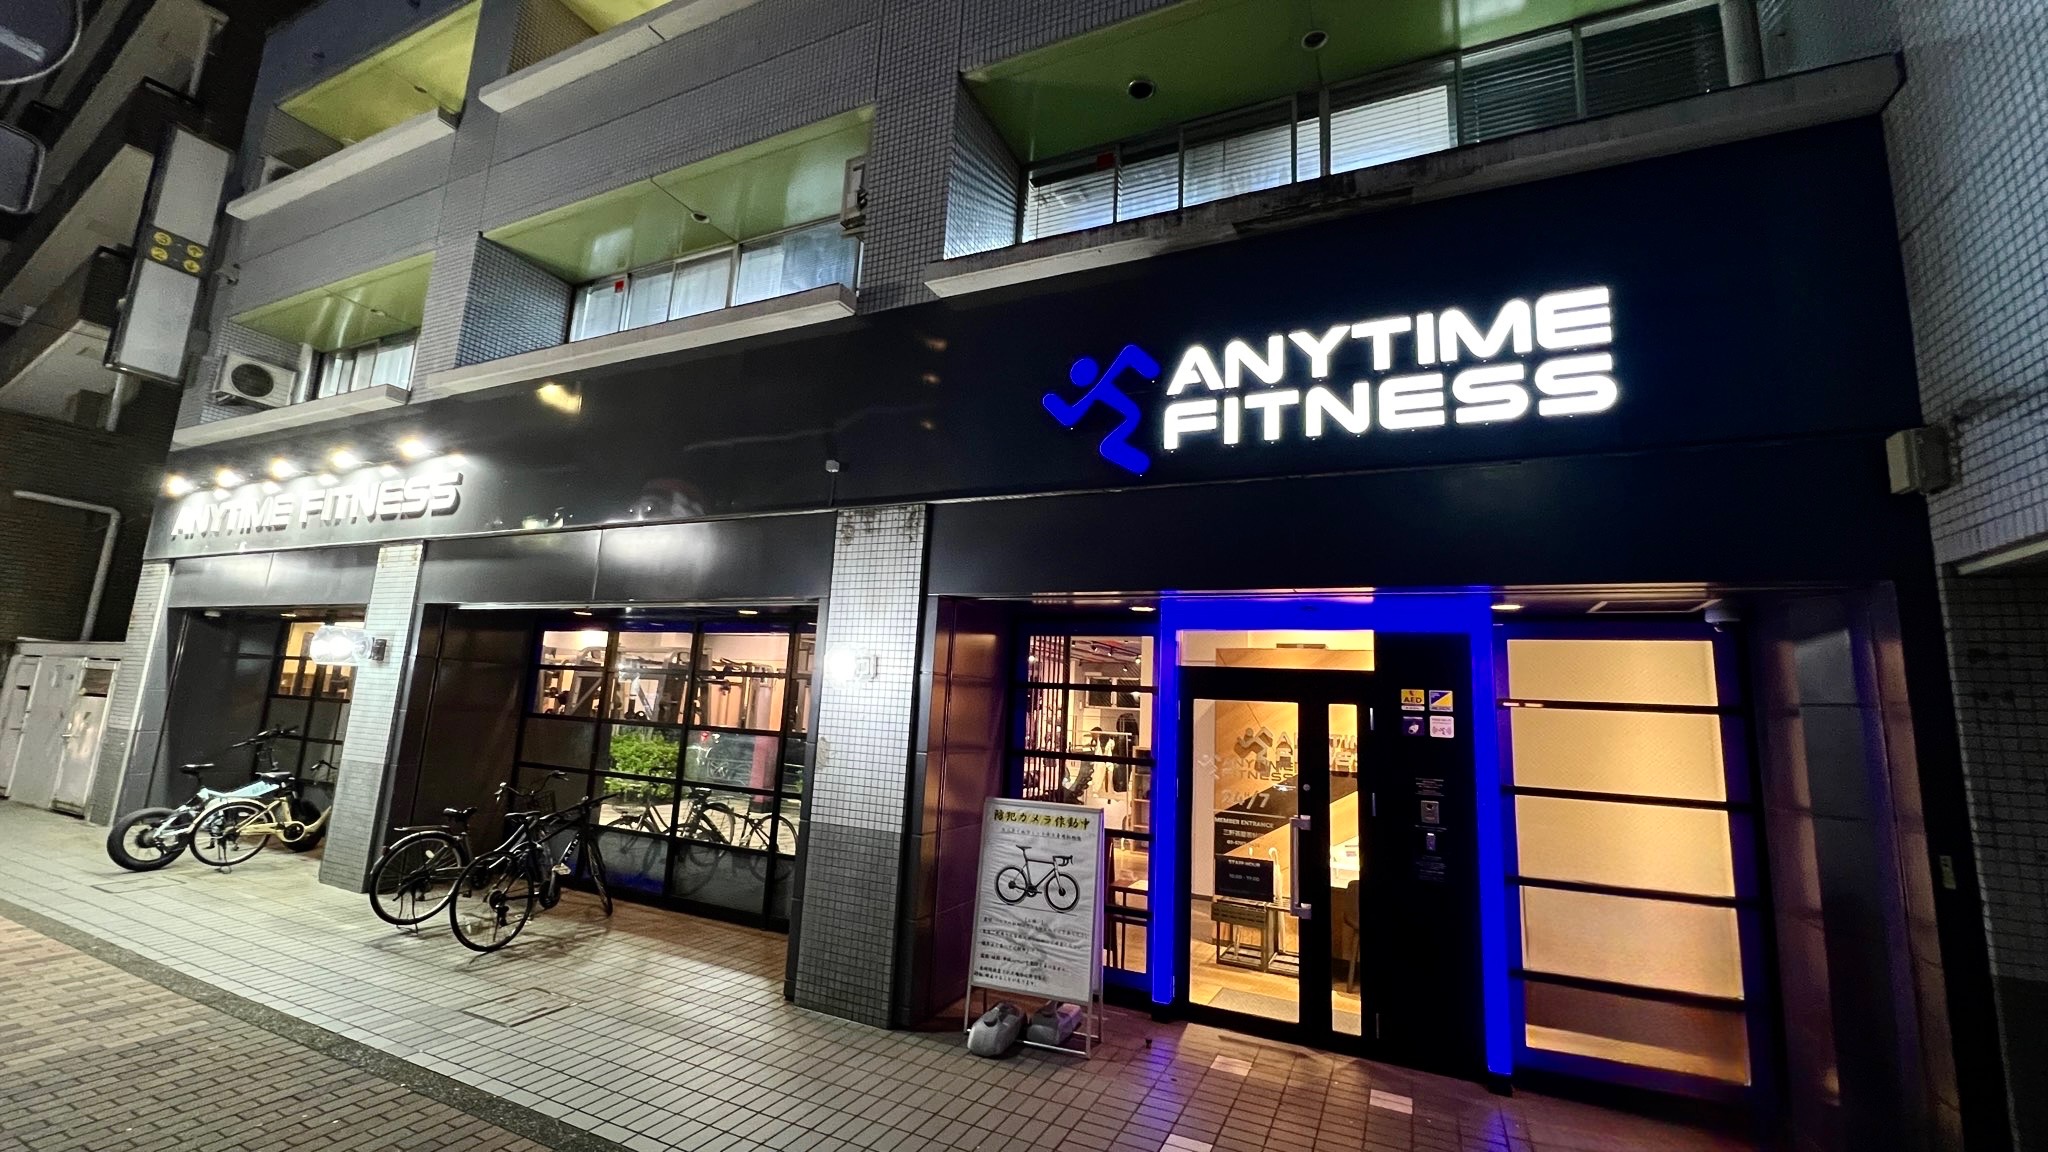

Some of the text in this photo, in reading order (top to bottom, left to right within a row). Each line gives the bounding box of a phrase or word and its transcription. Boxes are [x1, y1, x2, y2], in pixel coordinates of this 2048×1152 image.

[1165, 286, 1613, 396] ANYTIME
[1163, 353, 1618, 450] FITNESS
[171, 472, 464, 540] ANYTIME FITNESS
[994, 809, 1090, 831] 防犯カメラ作動中
